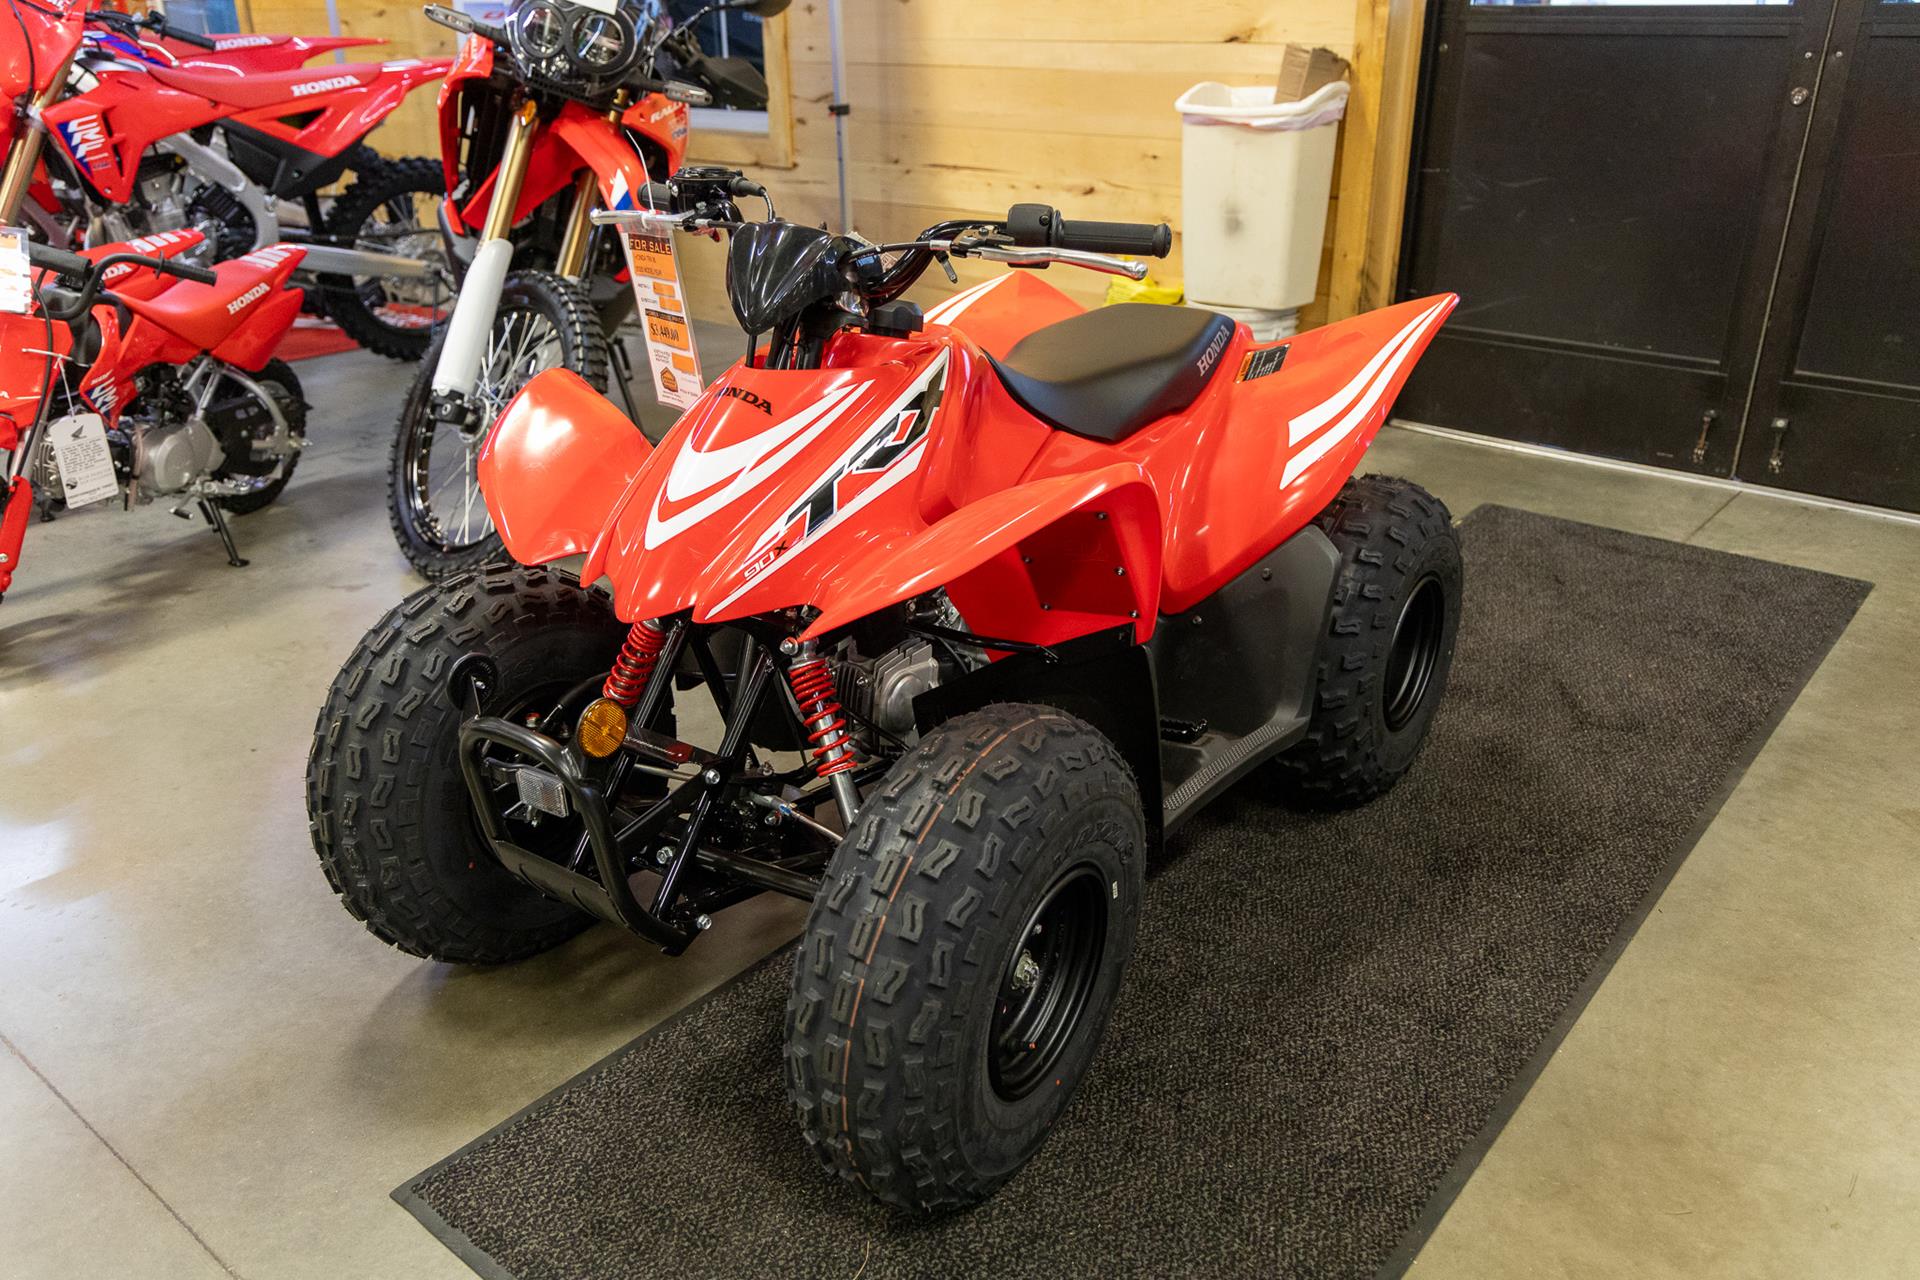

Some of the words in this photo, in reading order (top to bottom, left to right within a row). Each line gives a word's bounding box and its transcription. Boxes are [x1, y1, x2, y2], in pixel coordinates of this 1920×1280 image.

[215, 36, 273, 51] HONDA
[290, 75, 361, 97] HONDA
[67, 114, 106, 160] CRF
[629, 239, 647, 251] FOR
[649, 241, 672, 254] SALE
[226, 282, 271, 315] HONDA
[1196, 325, 1230, 377] HONDA
